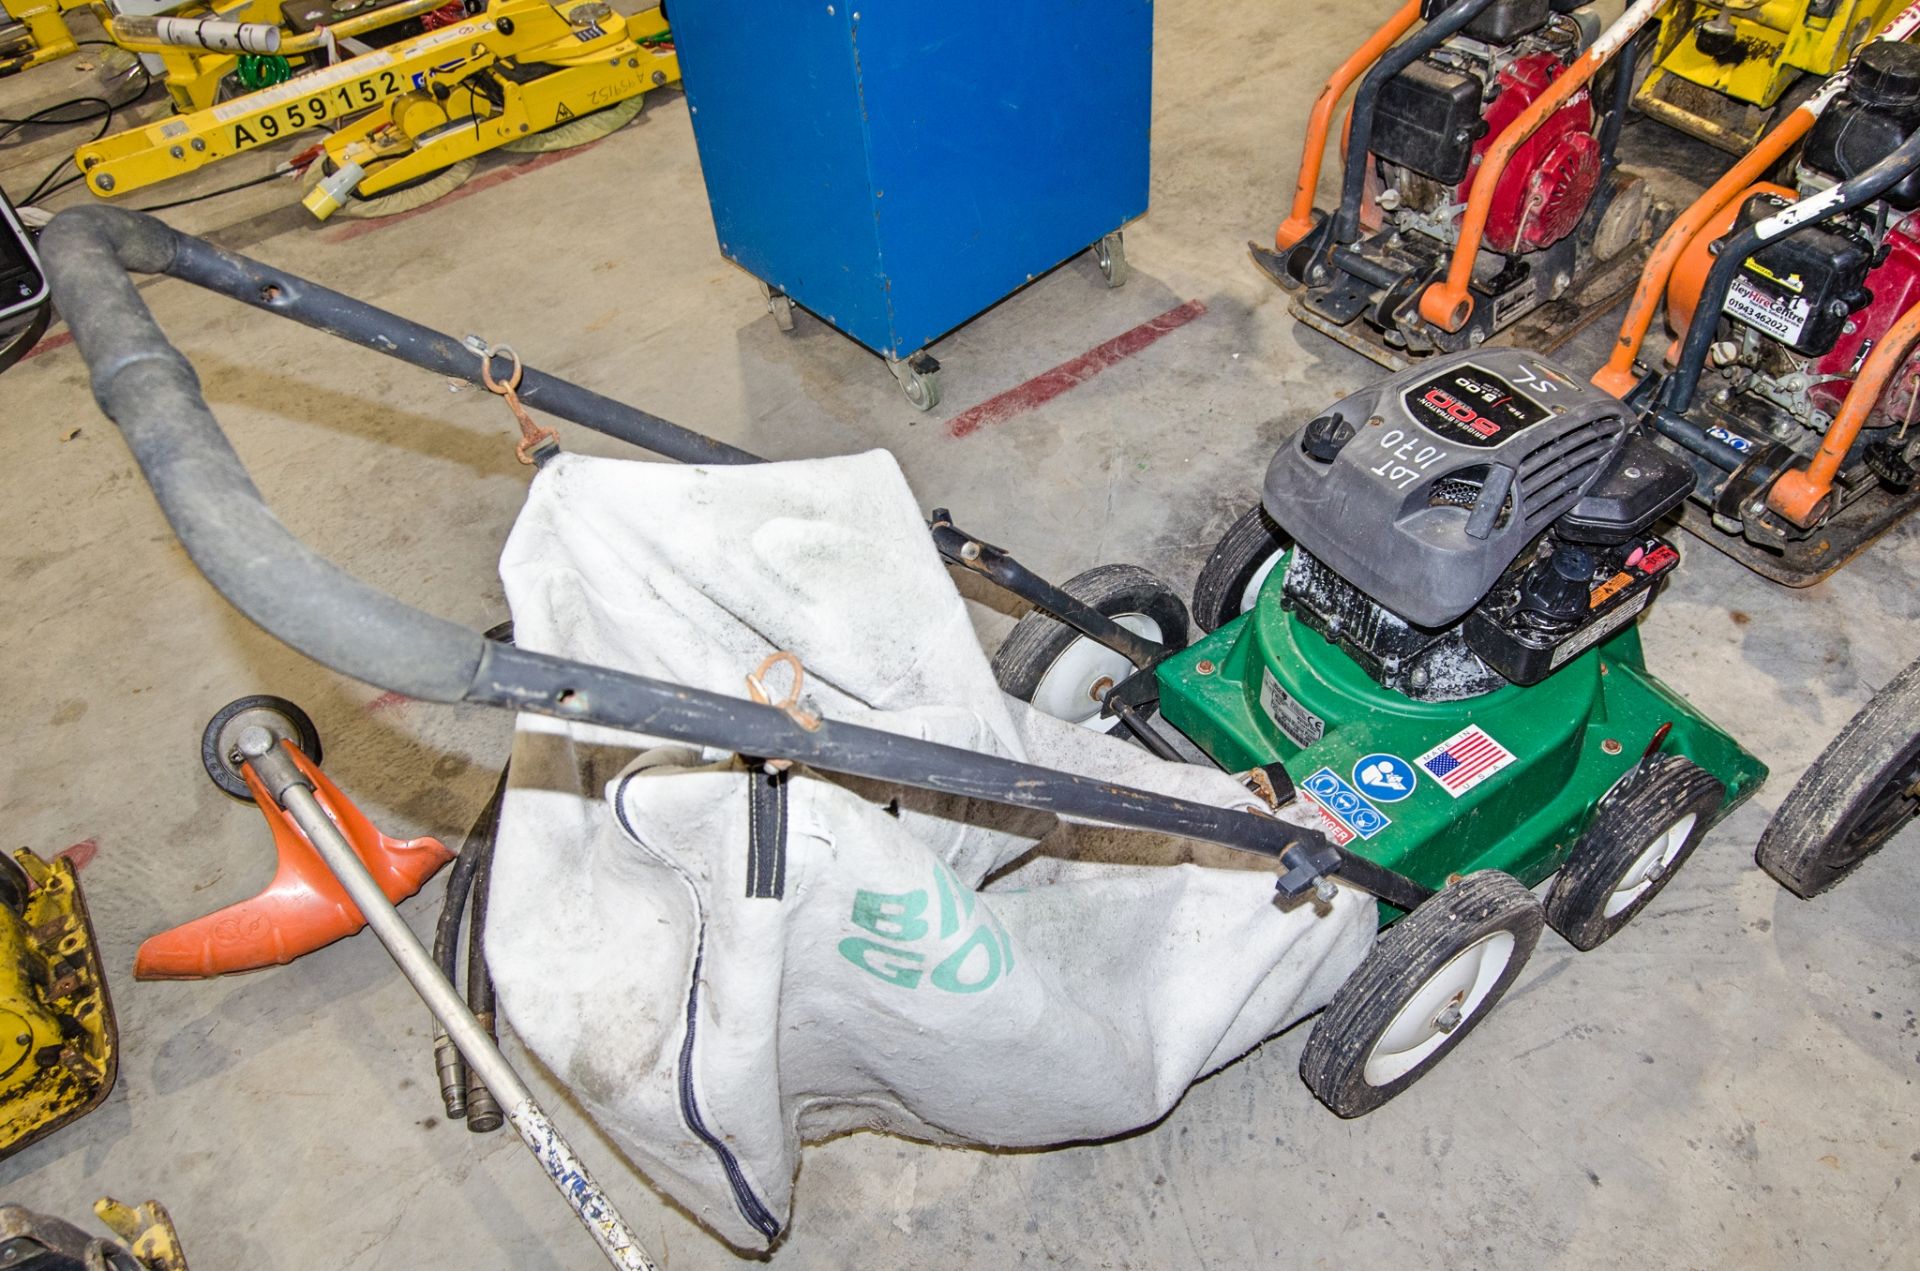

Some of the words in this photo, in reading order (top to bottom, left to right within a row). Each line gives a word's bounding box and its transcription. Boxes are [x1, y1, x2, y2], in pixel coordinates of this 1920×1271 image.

[234, 71, 399, 148] A959152
[1728, 298, 1754, 316] 01943
[1755, 311, 1789, 334] 462022
[1731, 281, 1804, 324] tleyHireCentre
[1424, 389, 1501, 437] 500
[1380, 430, 1447, 470] 1070
[1370, 460, 1420, 489] LOT
[1423, 742, 1451, 761] MADE
[1459, 730, 1471, 739] IN
